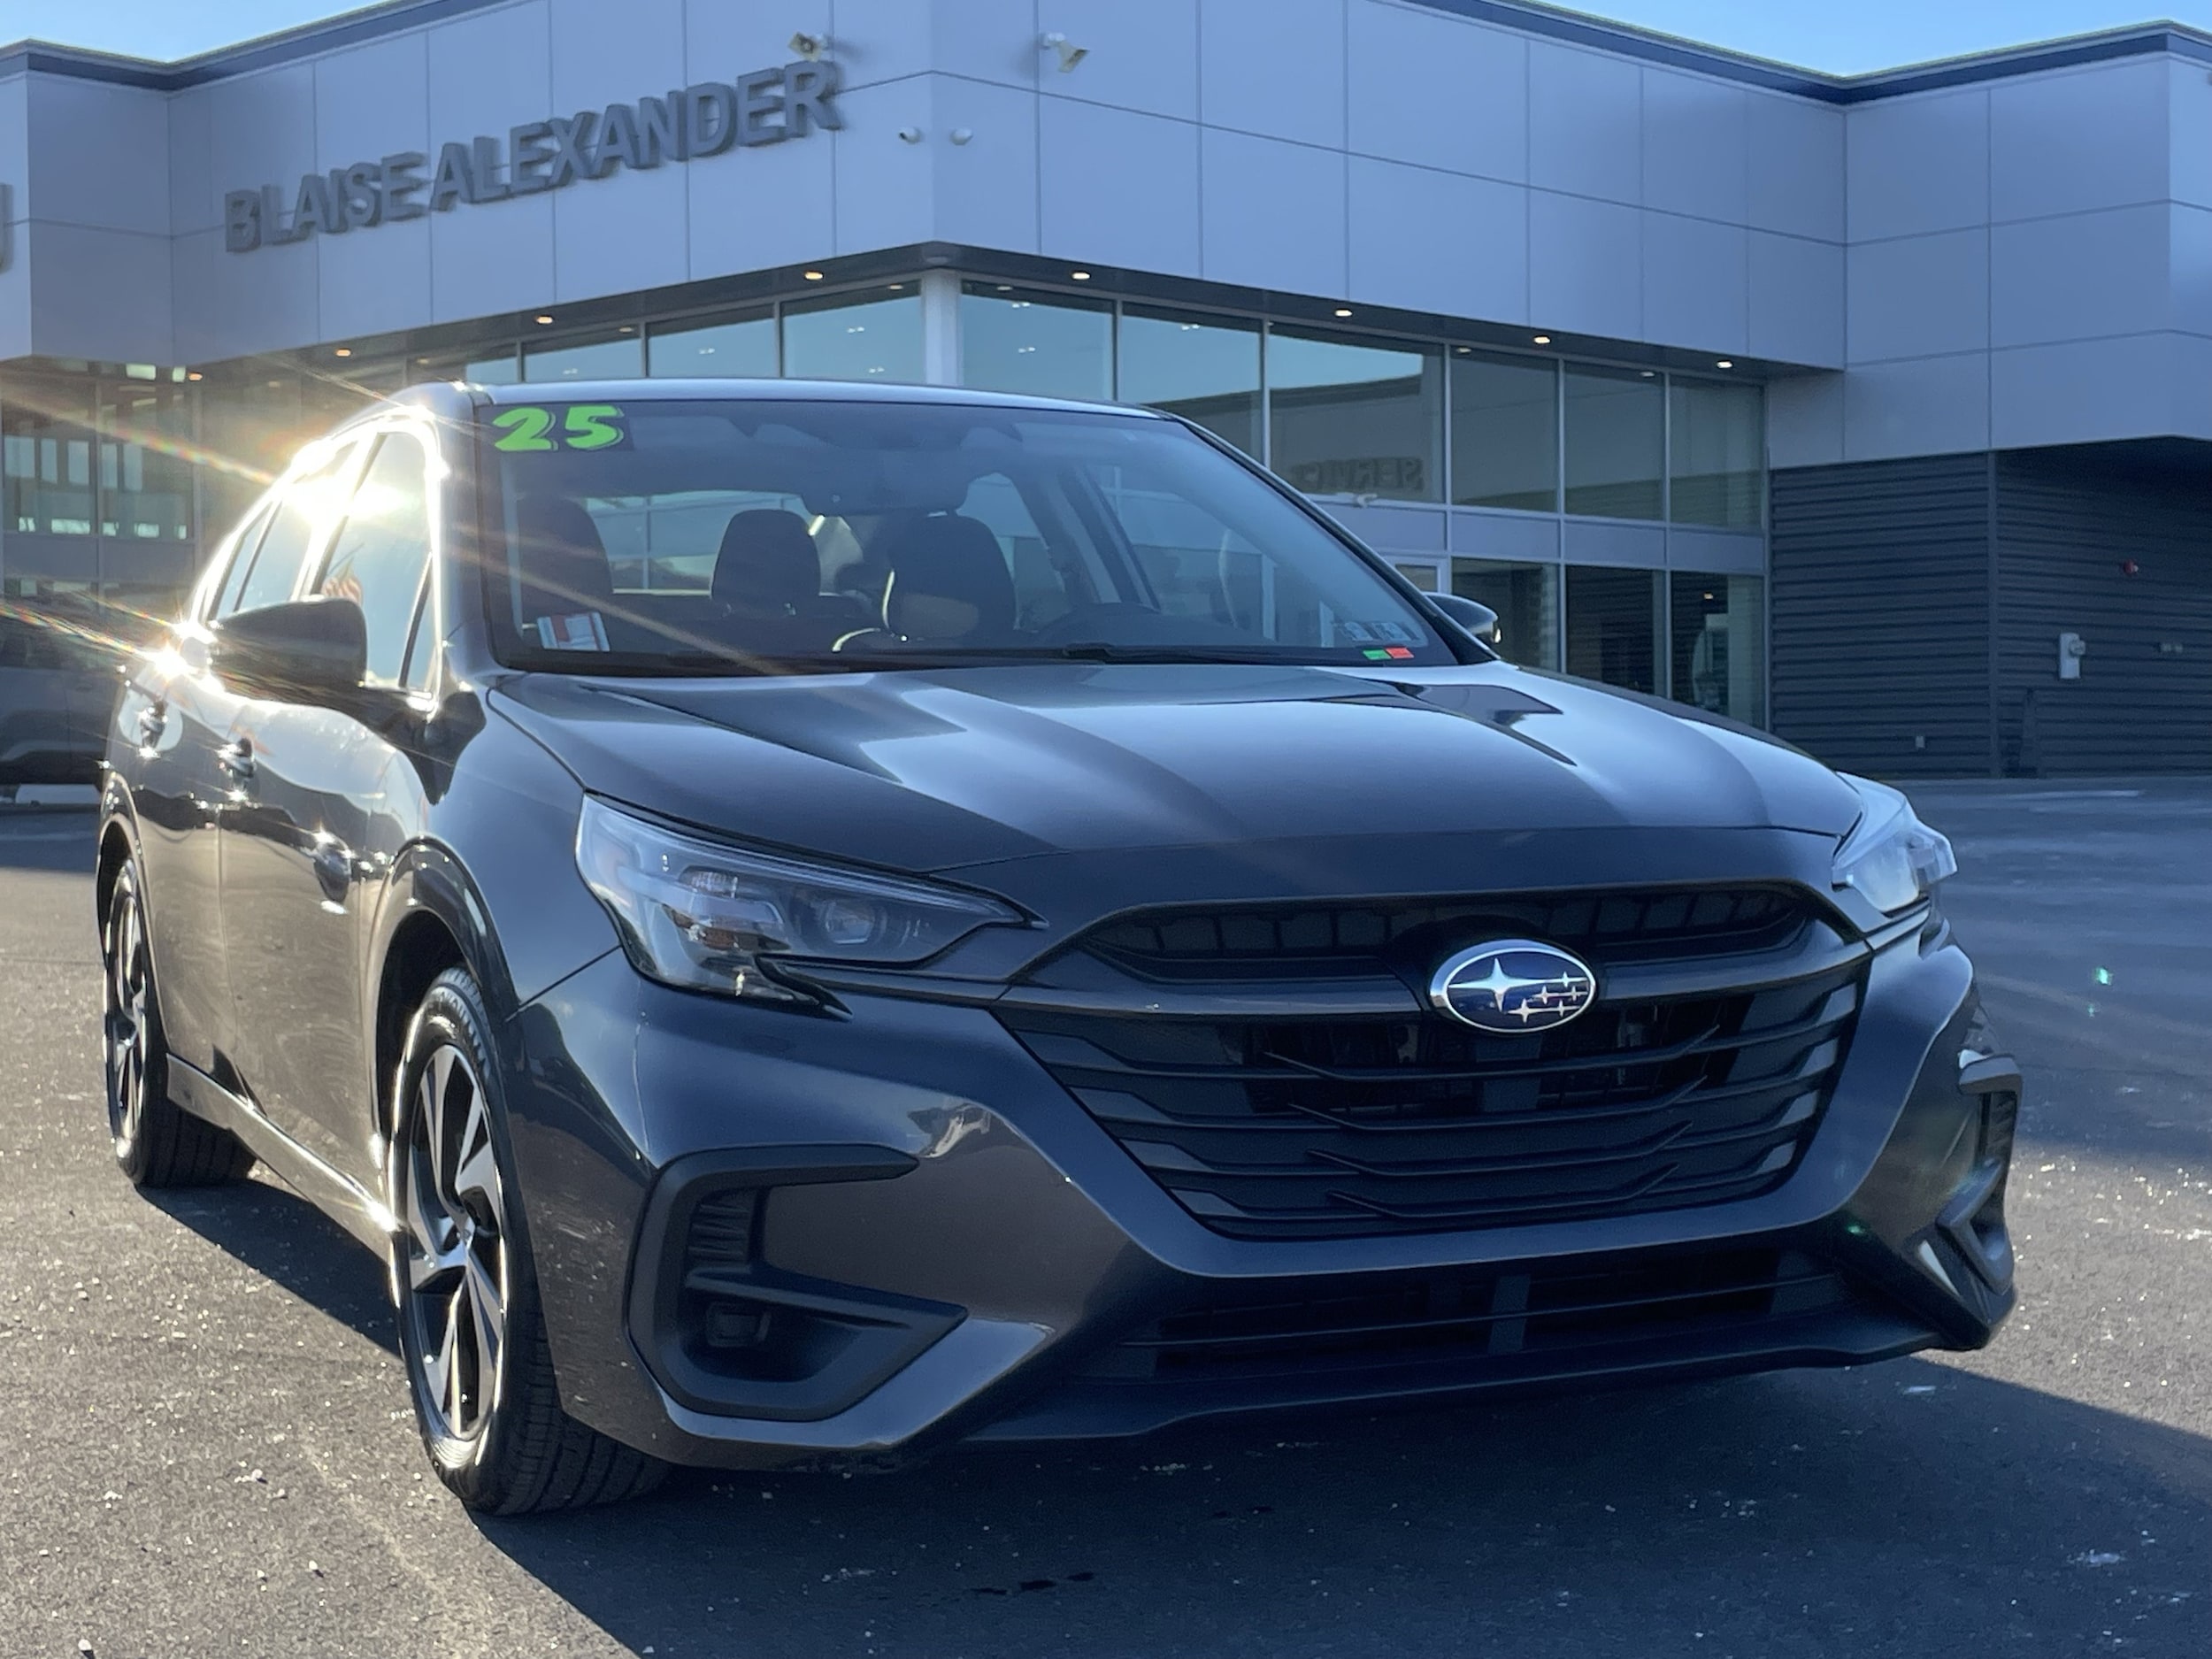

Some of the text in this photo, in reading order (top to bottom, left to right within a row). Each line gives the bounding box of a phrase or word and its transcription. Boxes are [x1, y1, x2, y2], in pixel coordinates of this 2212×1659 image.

[225, 59, 841, 253] BLAISE ALEXANDER
[492, 404, 624, 452] 25
